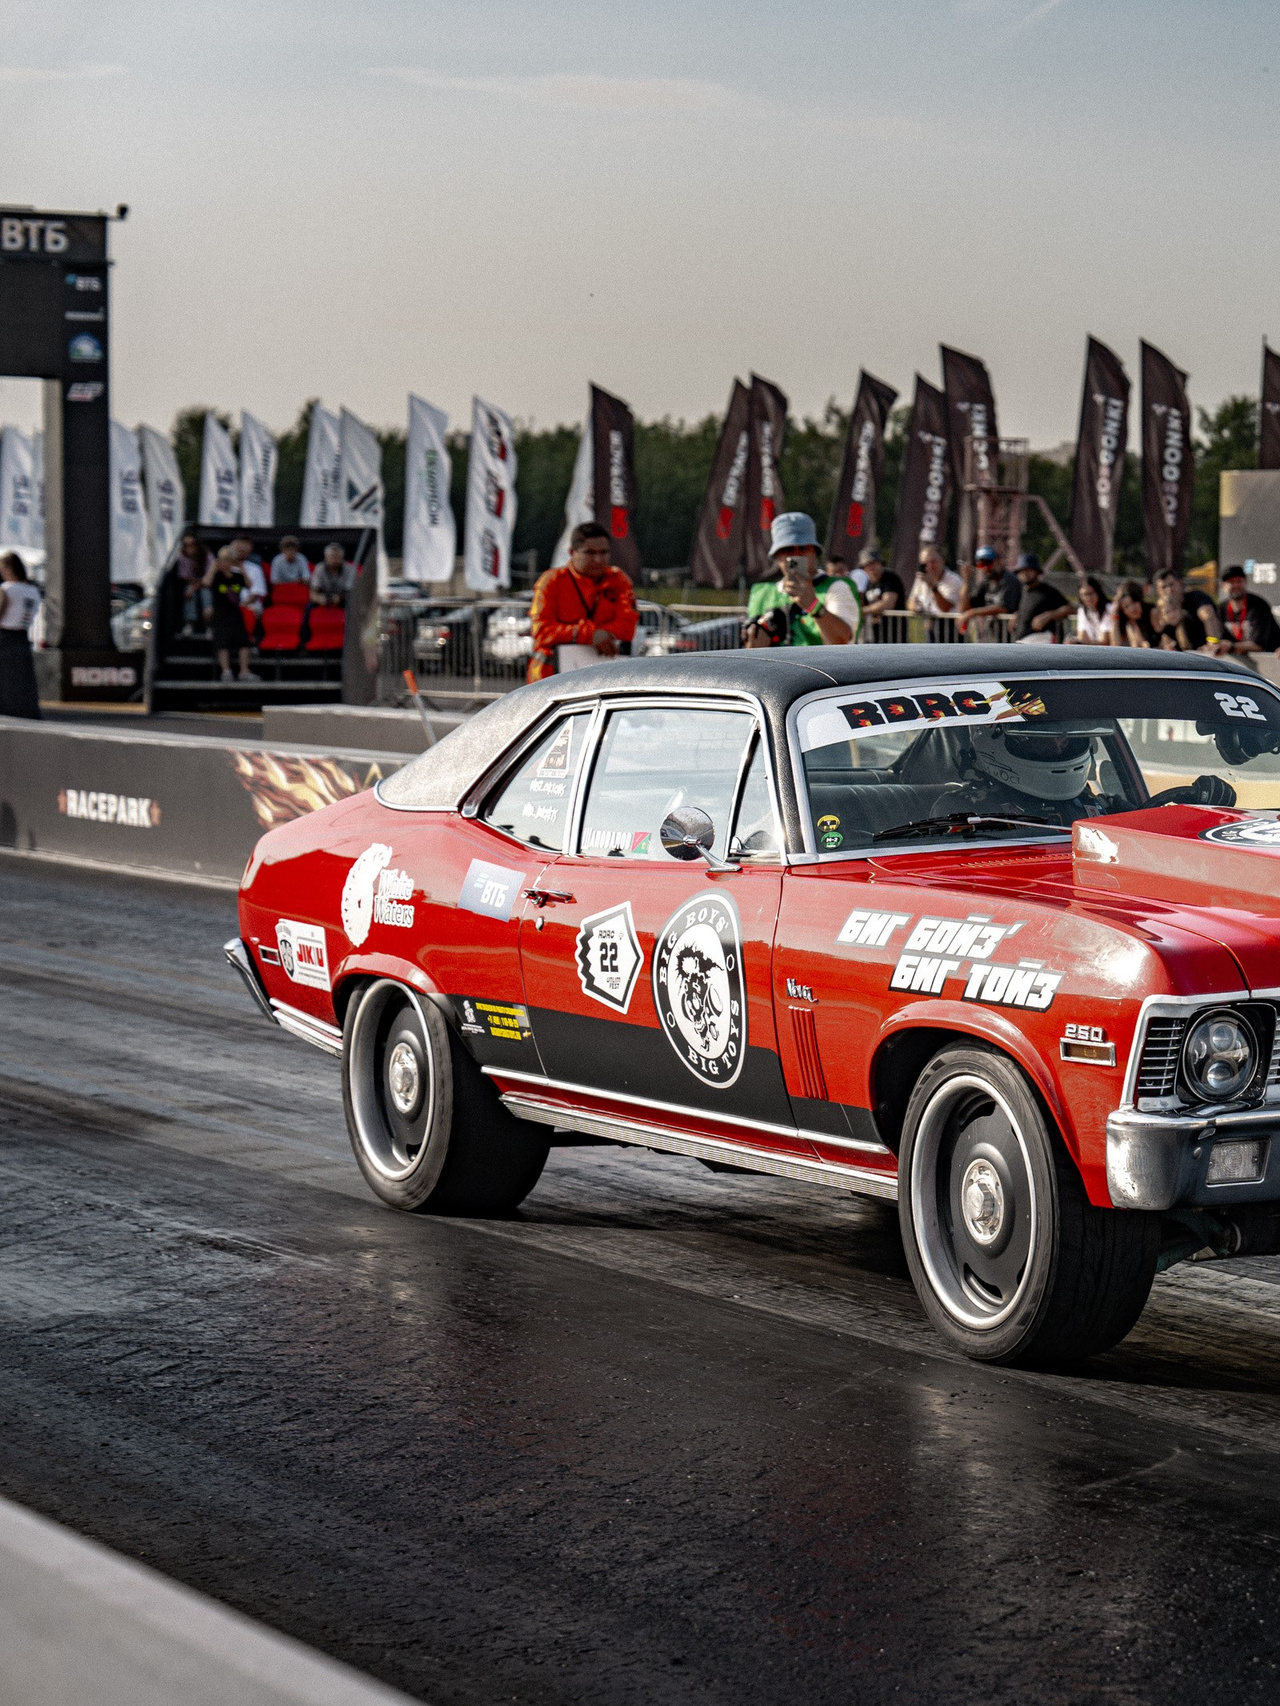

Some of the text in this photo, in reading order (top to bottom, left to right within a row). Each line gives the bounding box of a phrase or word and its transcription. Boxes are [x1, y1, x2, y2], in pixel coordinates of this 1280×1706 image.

[837, 690, 992, 730] RDRC
[1214, 692, 1268, 721] 22
[66, 788, 152, 829] RACEPARK
[379, 869, 415, 901] White
[480, 880, 509, 907] ВТБ
[373, 896, 415, 928] Waters
[837, 910, 911, 948] БИГ
[599, 942, 619, 972] 22
[786, 977, 818, 1003] Nova
[890, 954, 962, 995] БИГ
[1064, 1023, 1105, 1043] 250
[687, 1045, 720, 1075] BIG
